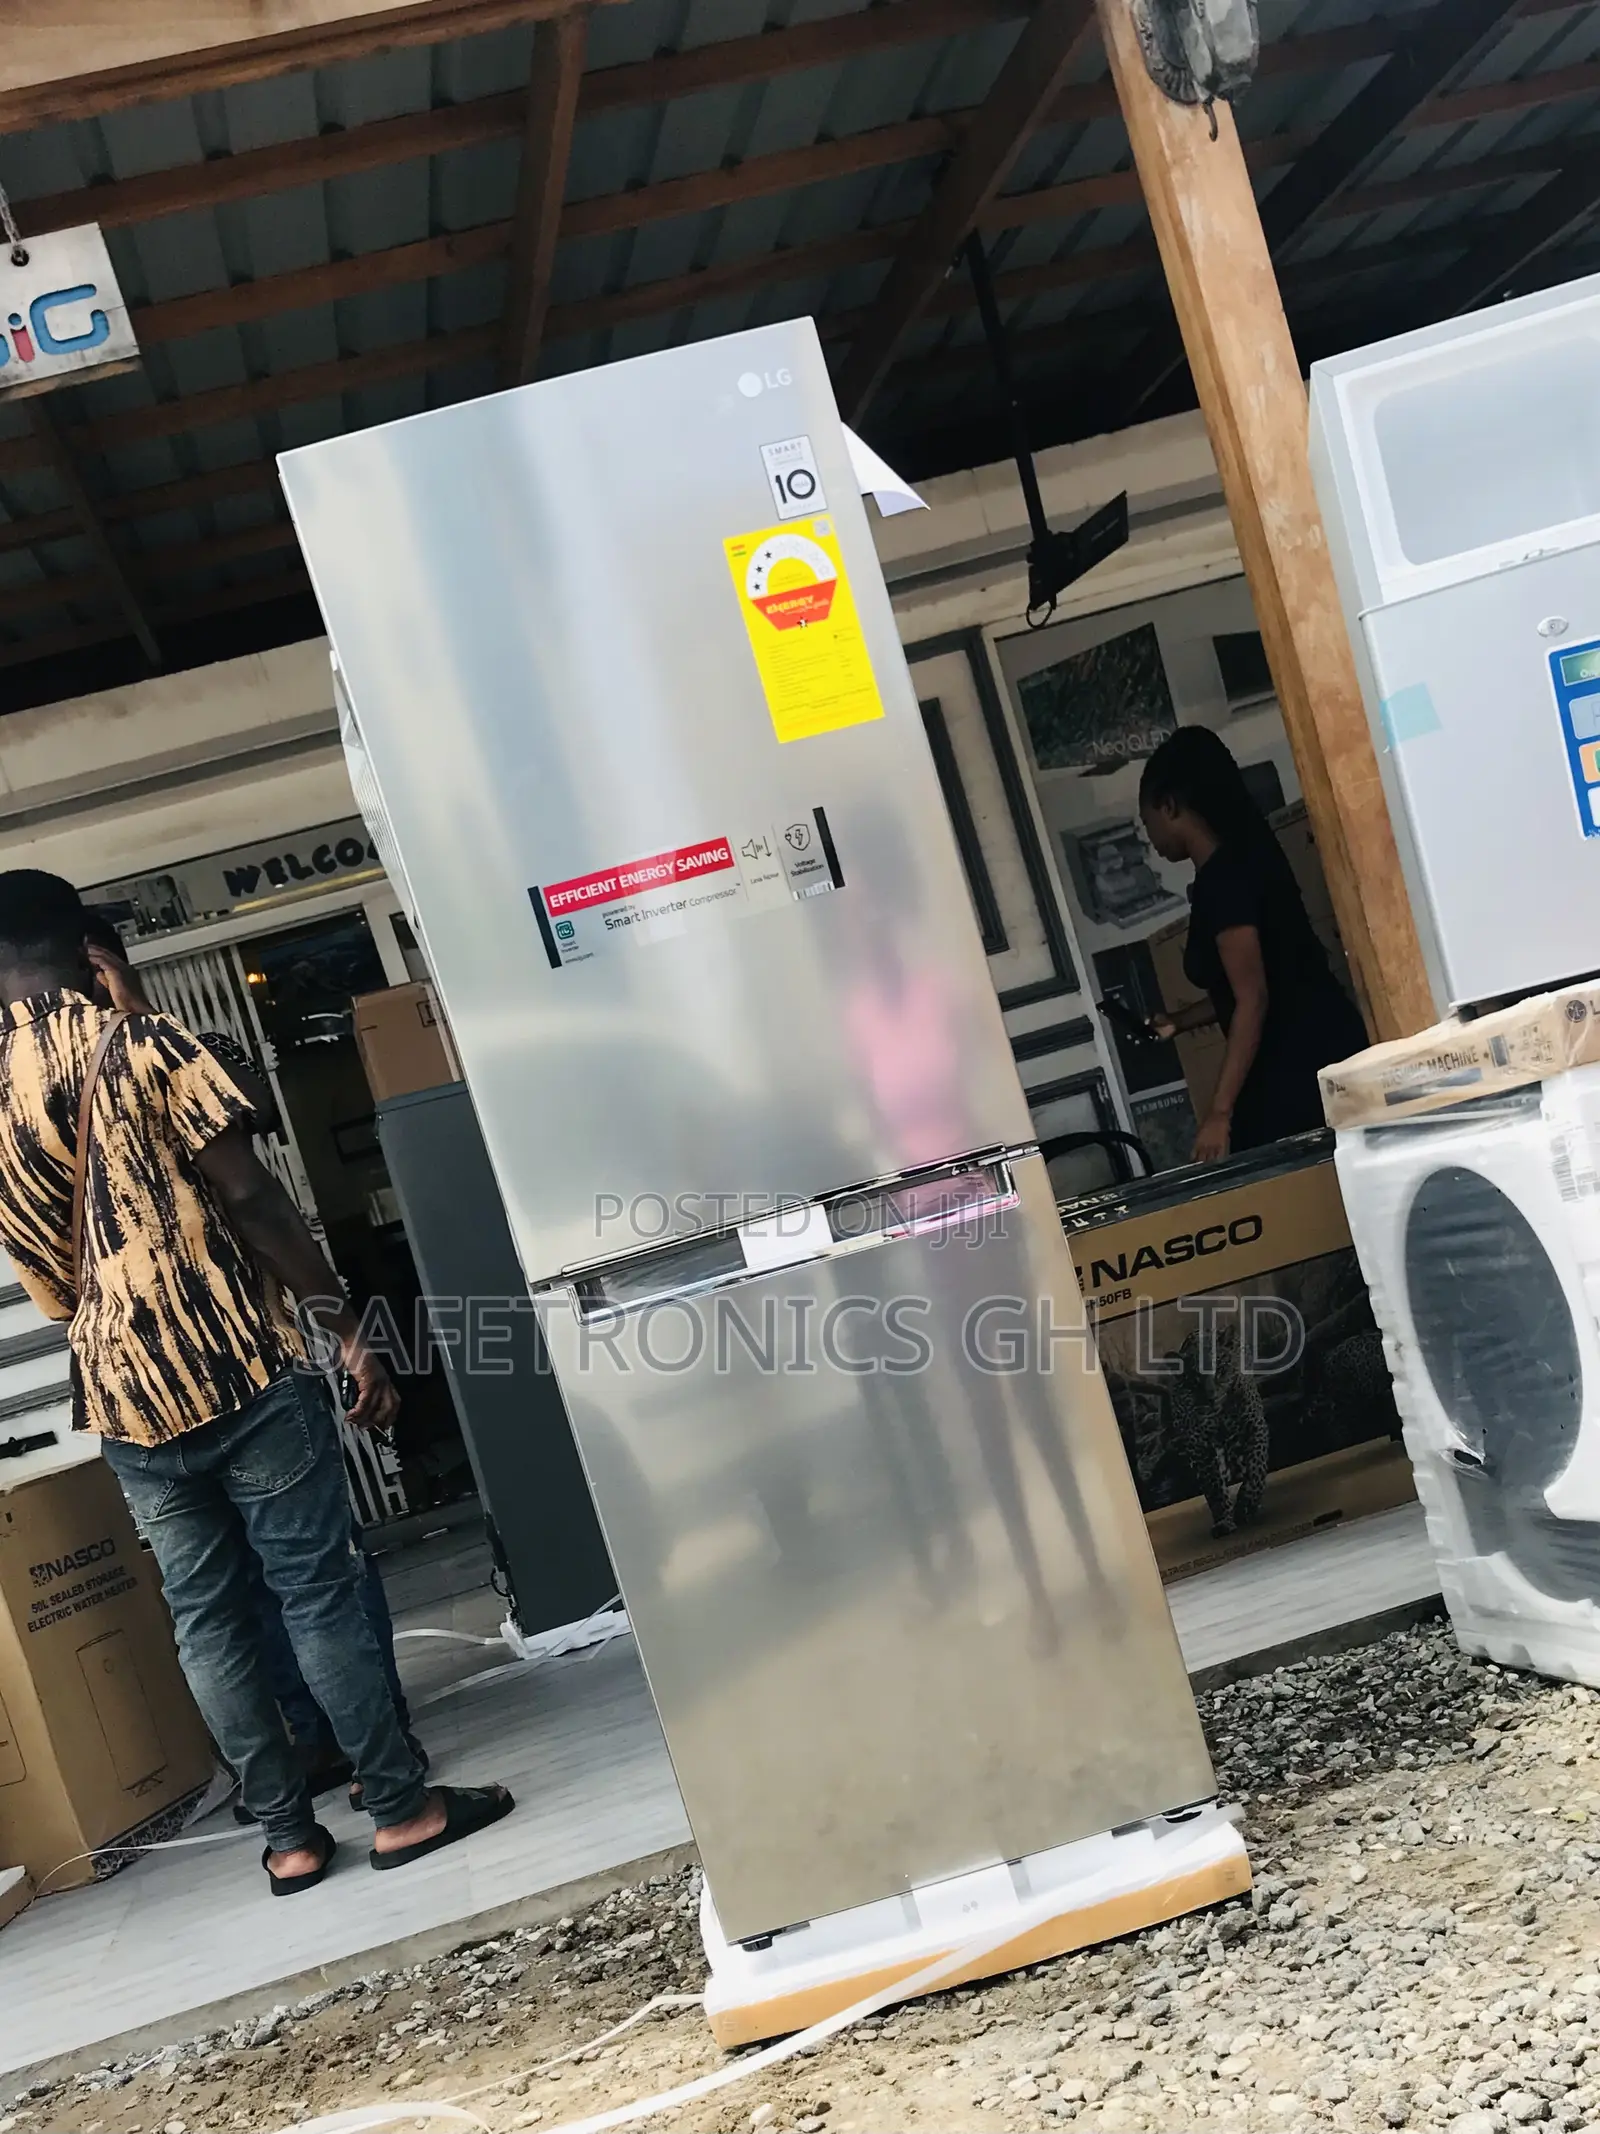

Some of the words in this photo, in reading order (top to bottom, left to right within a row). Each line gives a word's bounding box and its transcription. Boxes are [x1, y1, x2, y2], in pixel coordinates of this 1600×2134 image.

[764, 368, 792, 389] LG
[775, 468, 816, 504] 10
[549, 877, 617, 909] EFFICIENT
[619, 861, 675, 889] ENERGY
[676, 847, 729, 873] SAVING
[602, 906, 625, 918] powered
[605, 911, 641, 931] Smart
[642, 899, 688, 921] Inverter
[1426, 1045, 1480, 1074] MACHINE
[1135, 1094, 1185, 1116] SAMSUNG
[1091, 1214, 1263, 1289] NASCO
[44, 1537, 116, 1578] NASCO
[50, 1583, 85, 1607] SEALED
[85, 1565, 127, 1593] STORAGE
[27, 1605, 73, 1633] ELECTRIC
[75, 1592, 104, 1613] WATER
[104, 1576, 139, 1599] HEATER
